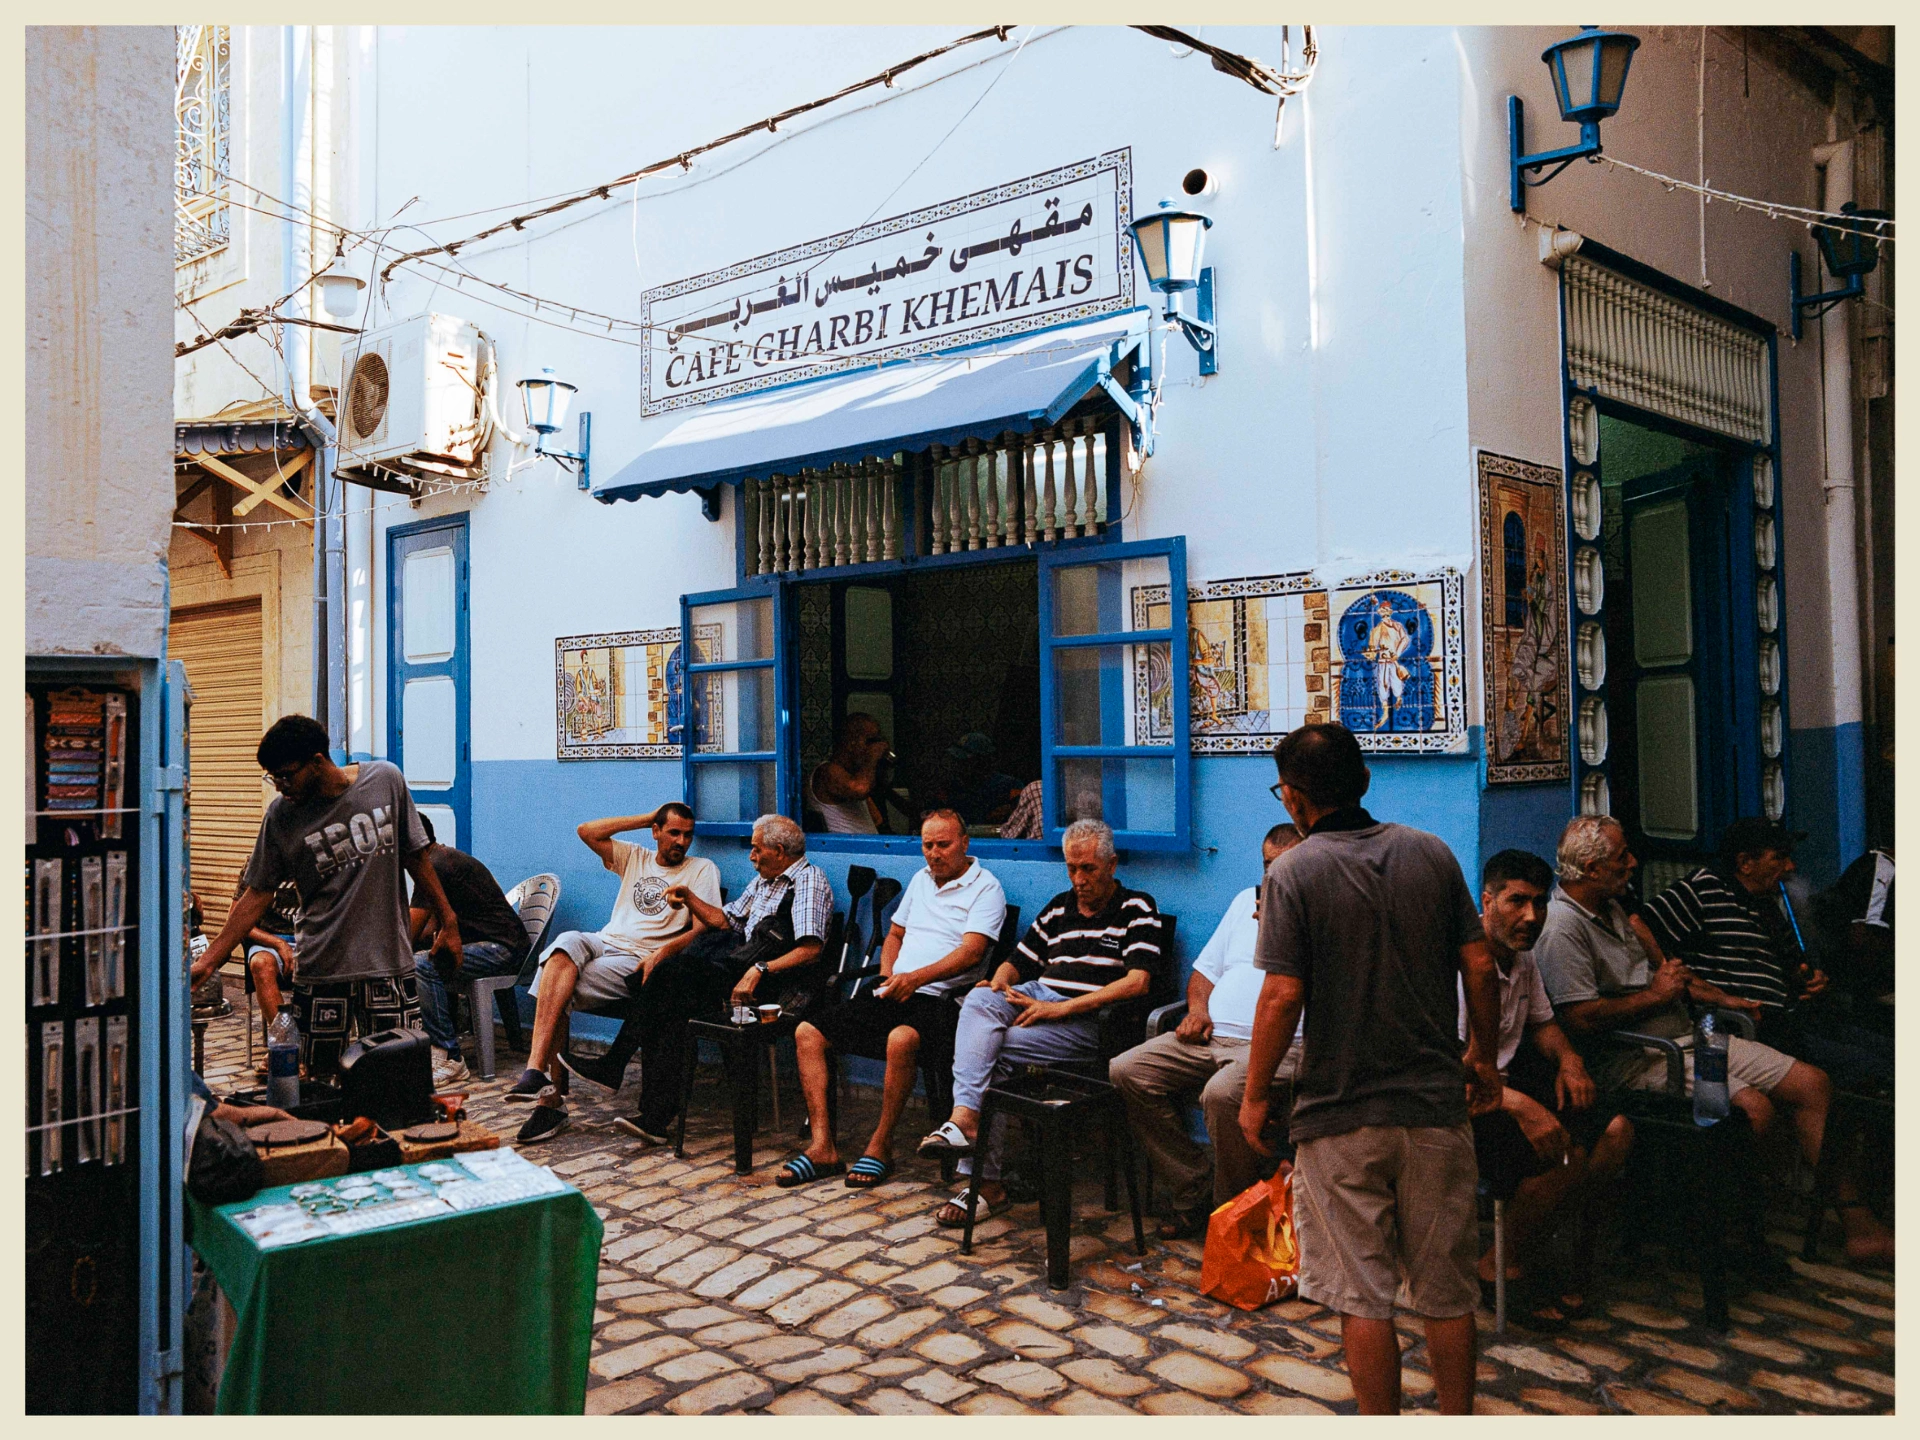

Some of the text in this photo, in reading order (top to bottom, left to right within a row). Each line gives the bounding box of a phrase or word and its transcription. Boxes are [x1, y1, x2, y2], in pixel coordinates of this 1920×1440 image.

[664, 254, 1093, 389] CAFE GHARBI KHEMAIS
[666, 196, 1093, 354] مقهى خميس الغربي
[304, 804, 395, 873] IRON
